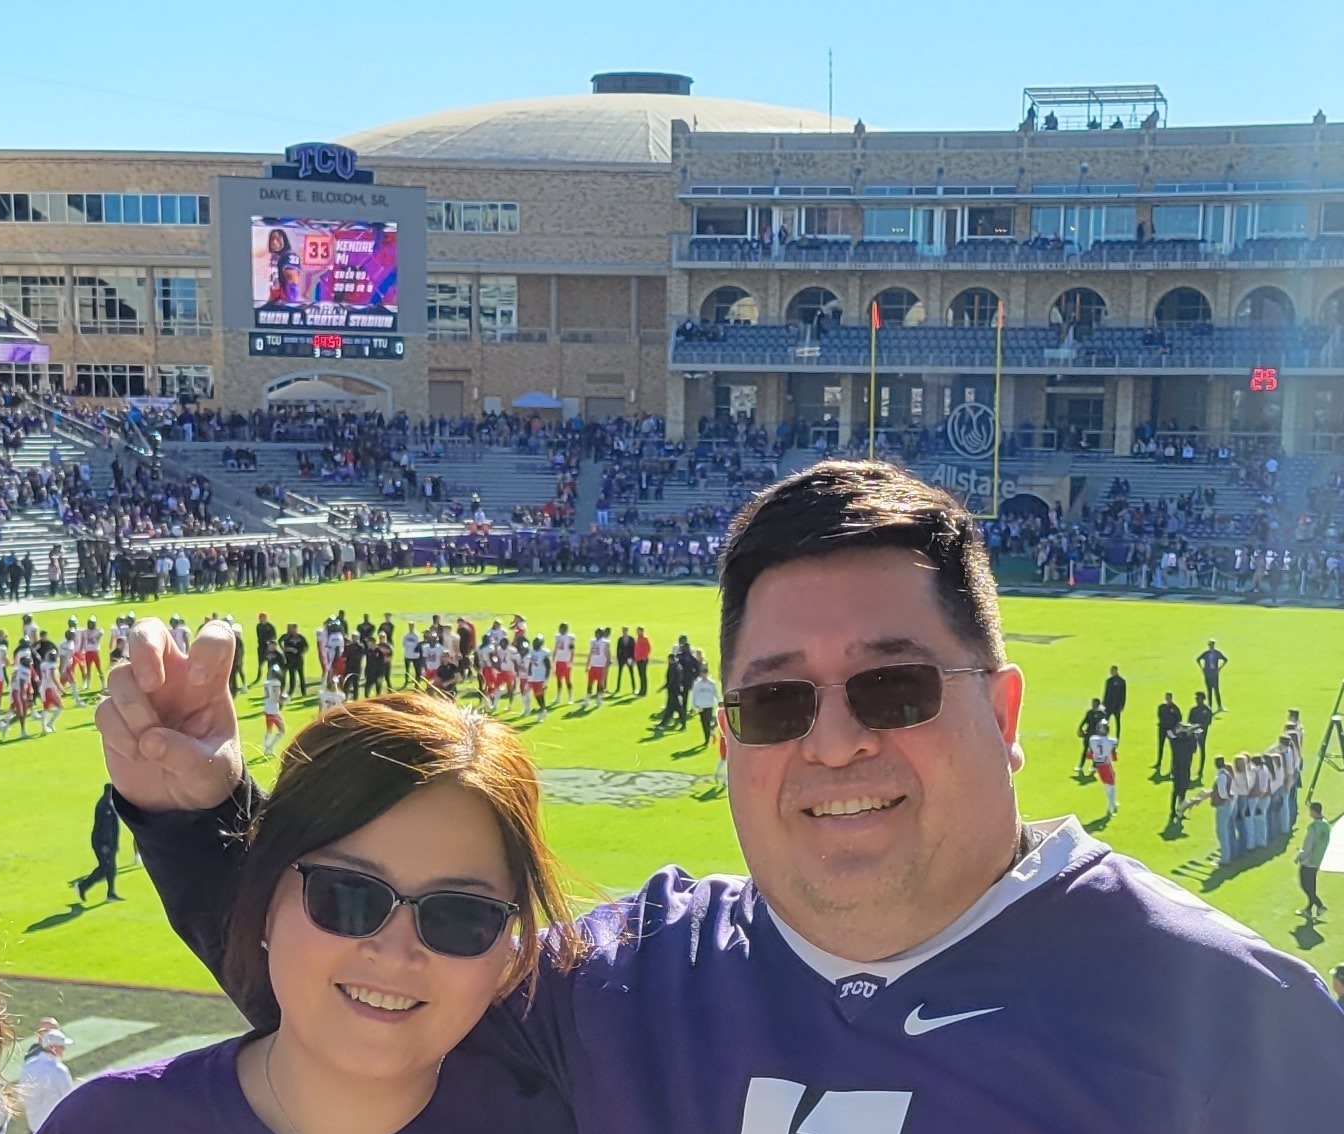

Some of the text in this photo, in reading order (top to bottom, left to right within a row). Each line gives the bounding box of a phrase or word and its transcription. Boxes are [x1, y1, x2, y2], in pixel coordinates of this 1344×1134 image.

[294, 143, 356, 180] TCU
[259, 187, 291, 201] DAVE
[931, 463, 1017, 499] Allstae
[839, 980, 878, 999] TCU
